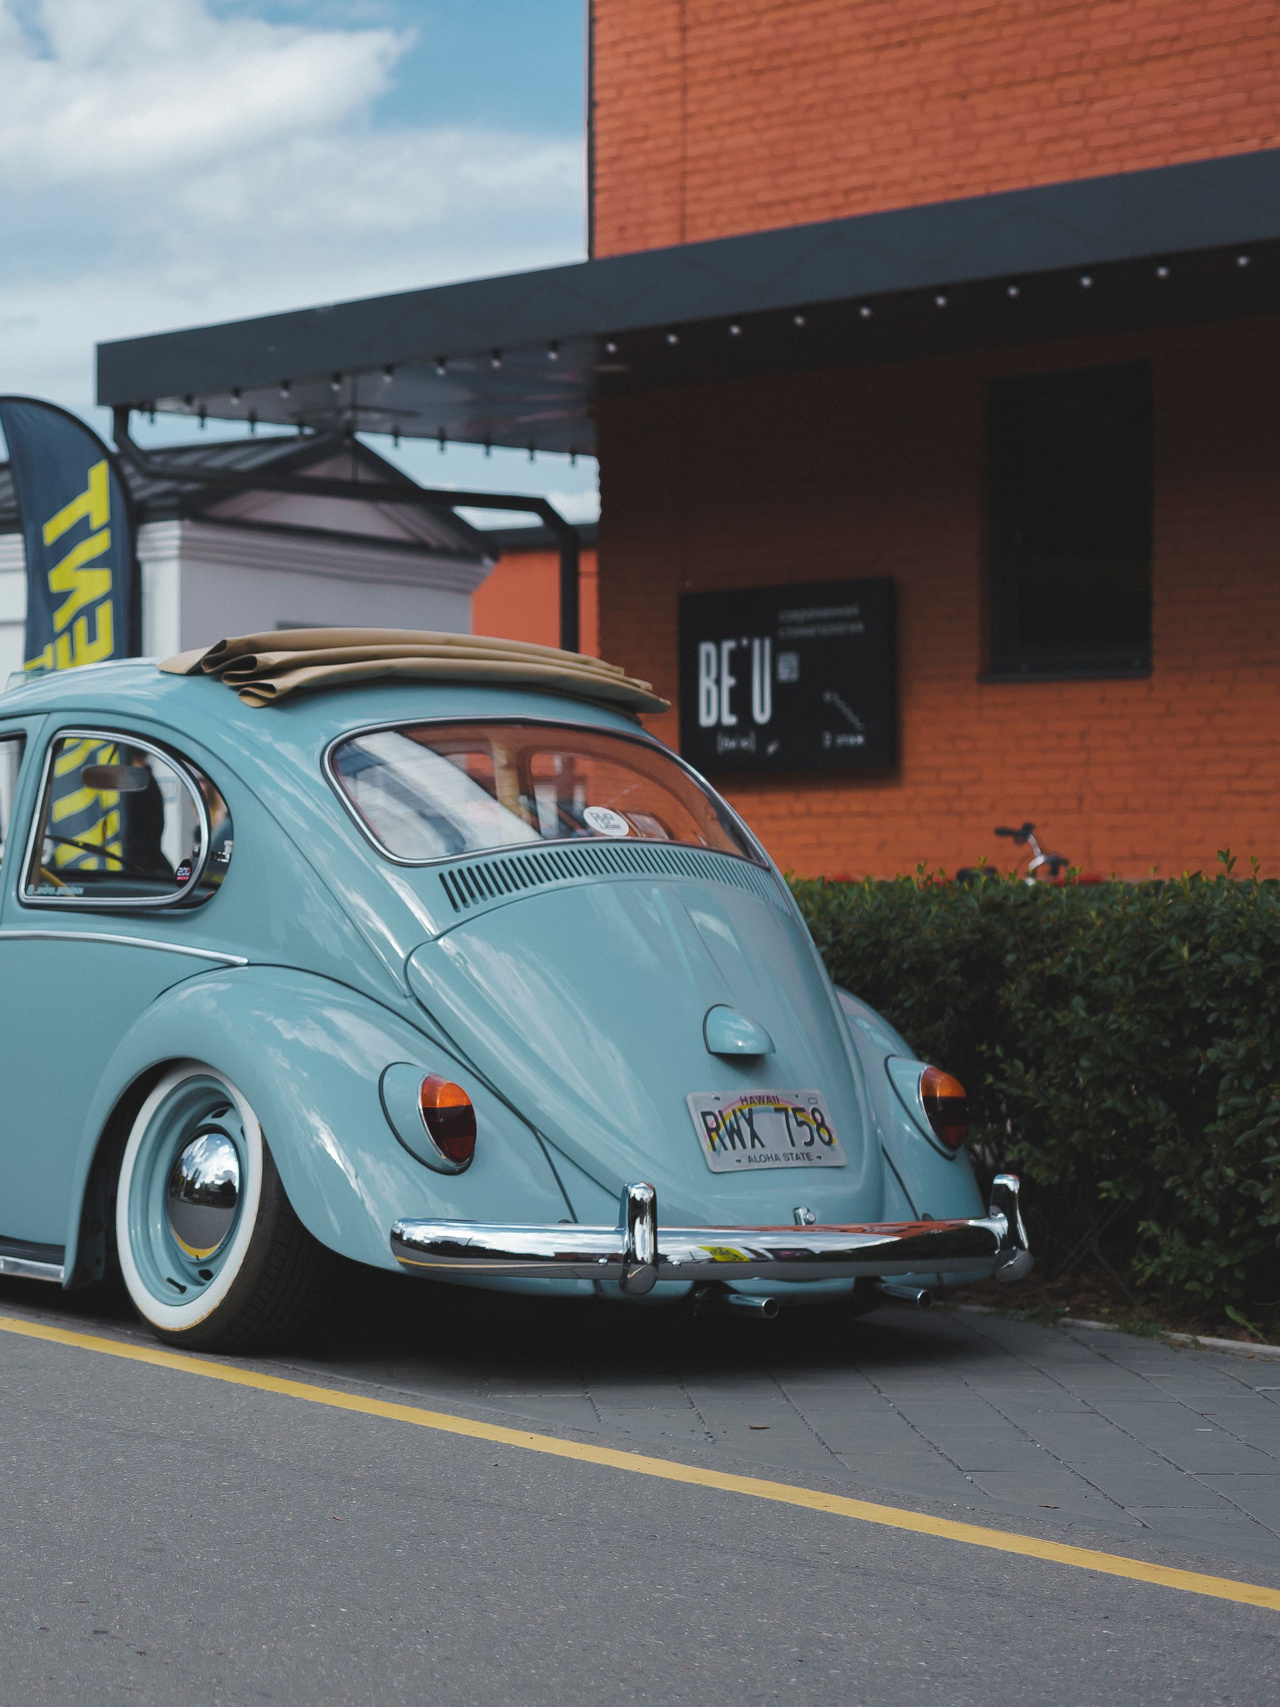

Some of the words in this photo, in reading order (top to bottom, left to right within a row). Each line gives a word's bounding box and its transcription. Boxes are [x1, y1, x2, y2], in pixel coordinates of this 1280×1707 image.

[739, 1094, 781, 1106] HAWAII
[700, 1108, 766, 1152] RWX
[773, 1106, 833, 1148] 758
[747, 1152, 781, 1164] ALOHA
[782, 1151, 814, 1162] STATE
